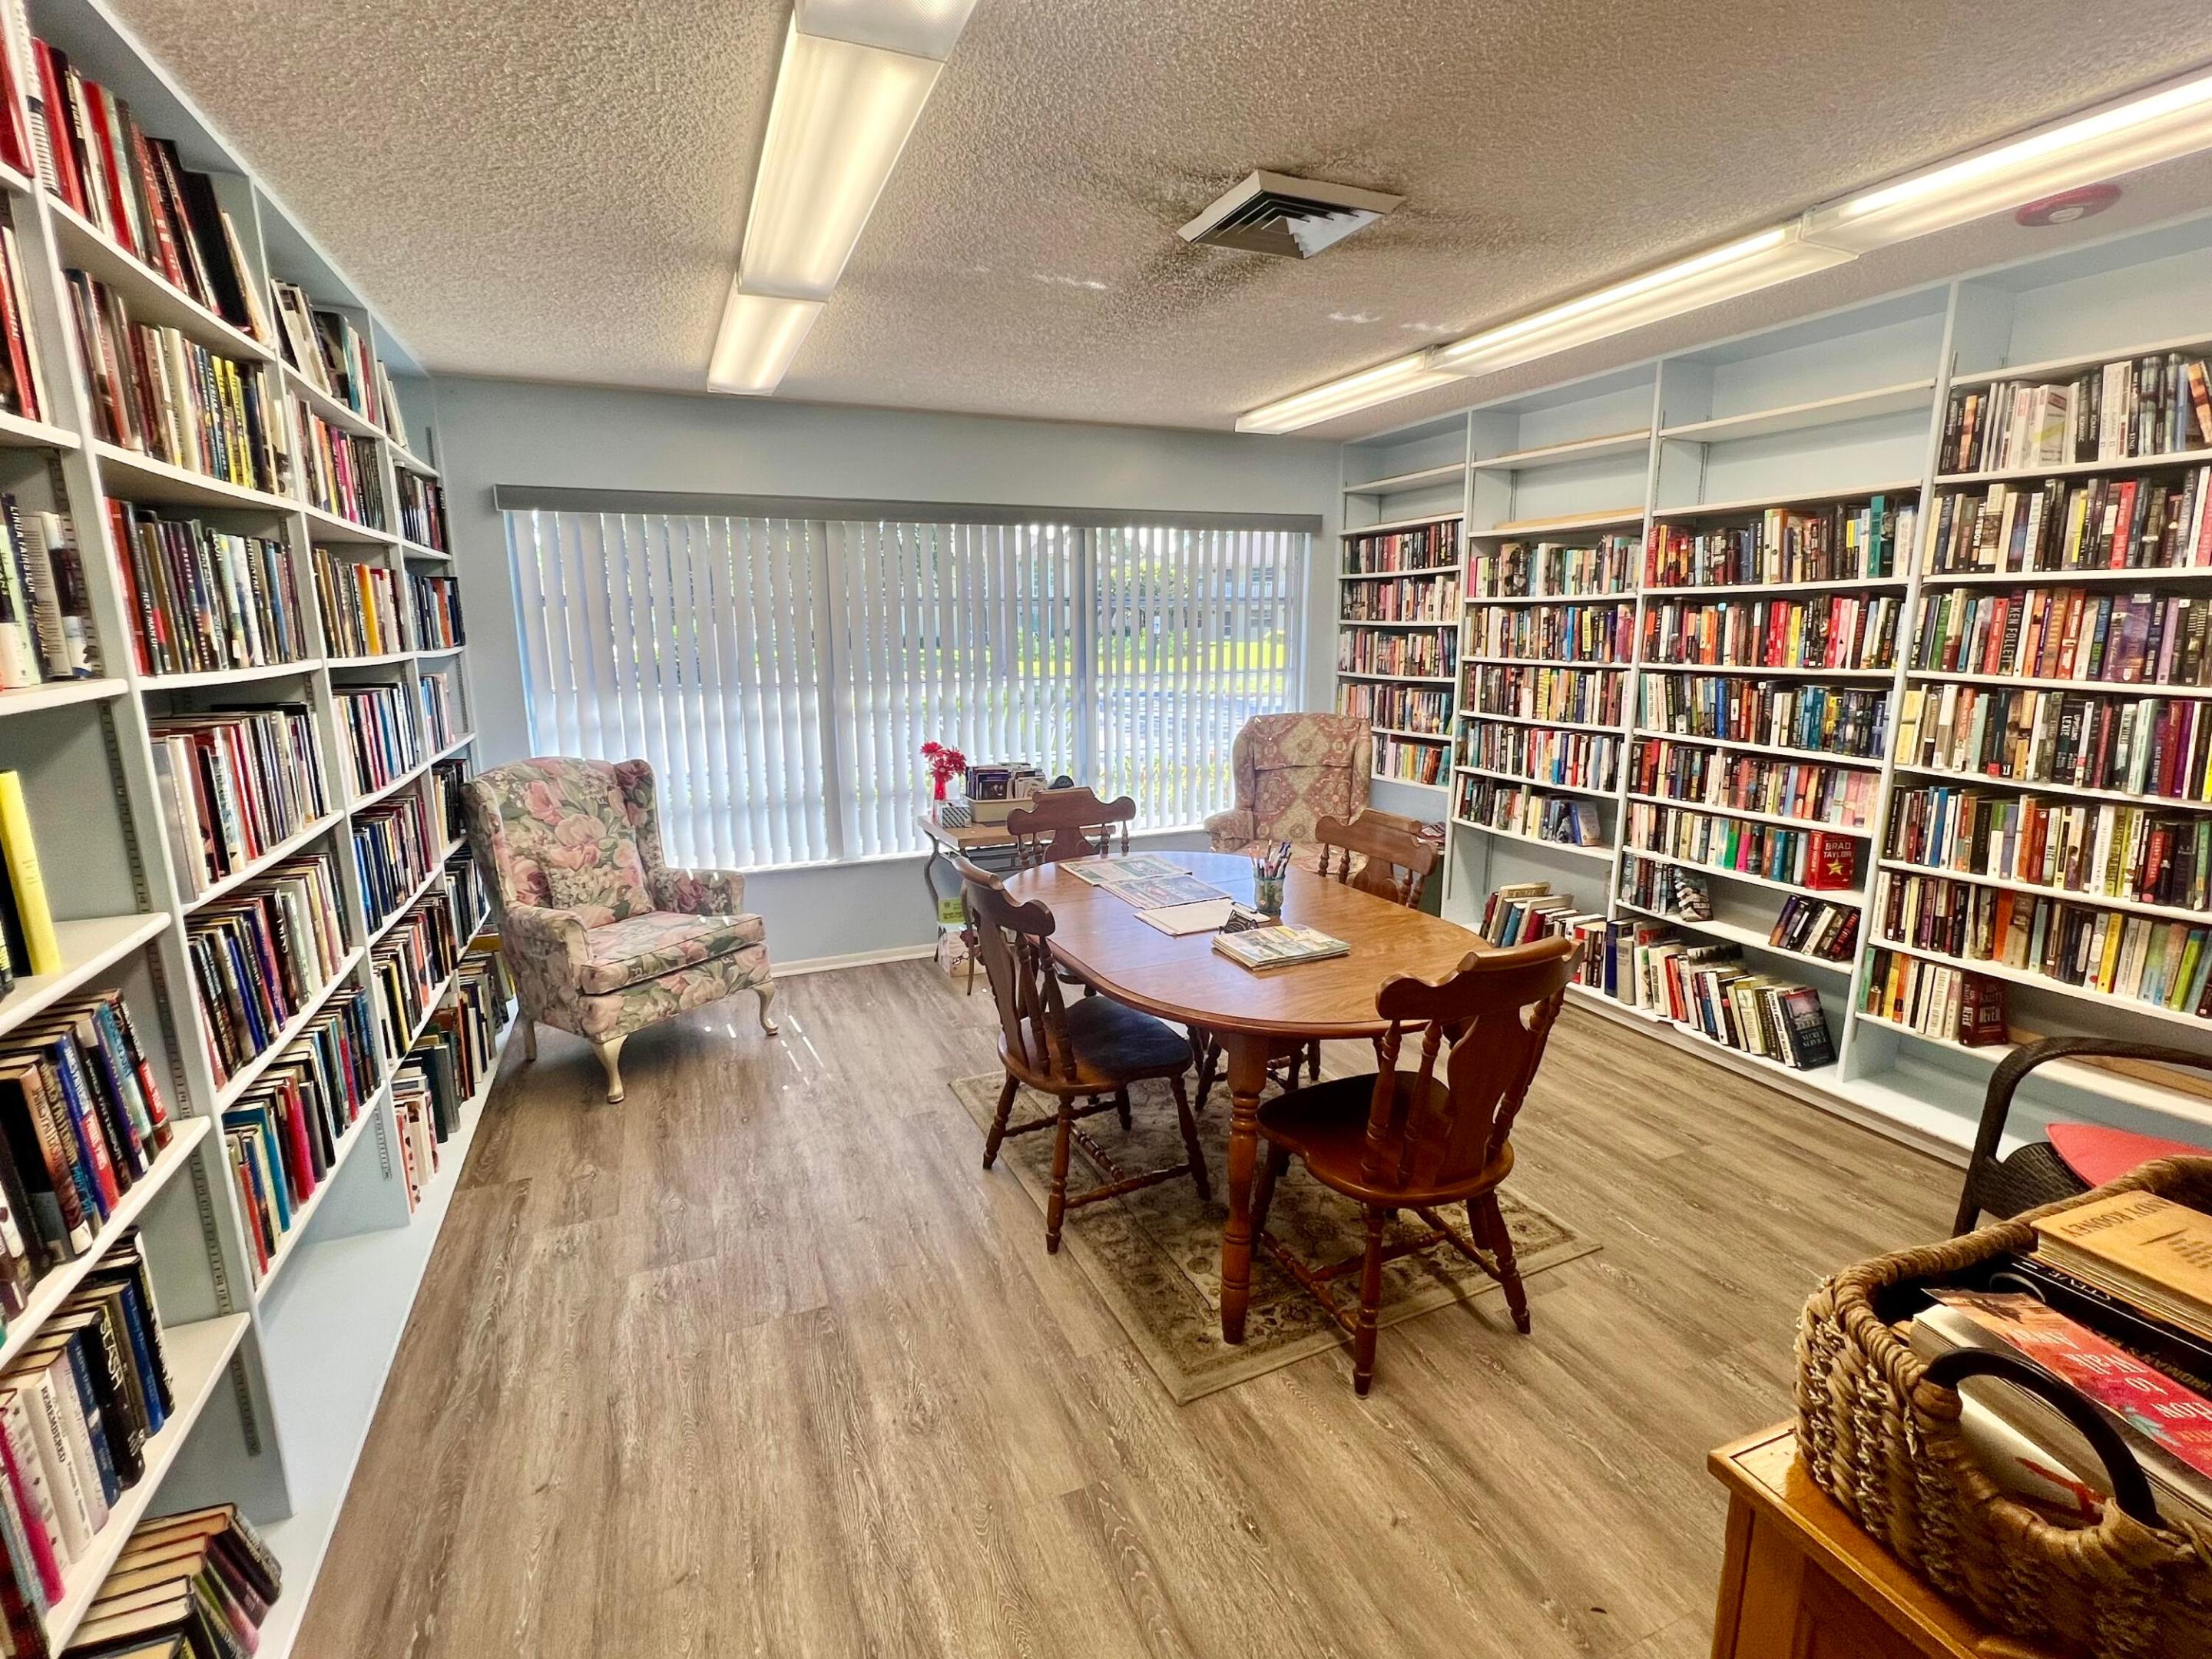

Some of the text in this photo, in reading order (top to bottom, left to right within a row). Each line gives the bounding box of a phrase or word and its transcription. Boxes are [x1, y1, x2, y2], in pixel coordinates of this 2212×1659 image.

[9, 505, 24, 538] LINDA
[1972, 502, 1985, 546] TIM TEBOW
[142, 591, 151, 614] NEXT
[147, 615, 156, 635] MAN
[2002, 606, 2019, 664] KEN FOLLETT
[2060, 714, 2071, 736] LEXIE
[1825, 843, 1852, 851] BRAD
[2045, 844, 2055, 861] NICE
[1962, 1006, 1972, 1027] NEVER
[1801, 1031, 1825, 1041] SECRET
[1803, 1037, 1827, 1048] SERVICE
[2059, 1209, 2134, 1238] ROONEY
[96, 1318, 124, 1389] SLASH
[2125, 1376, 2168, 1395] to
[38, 1386, 67, 1463] REMEMBERED
